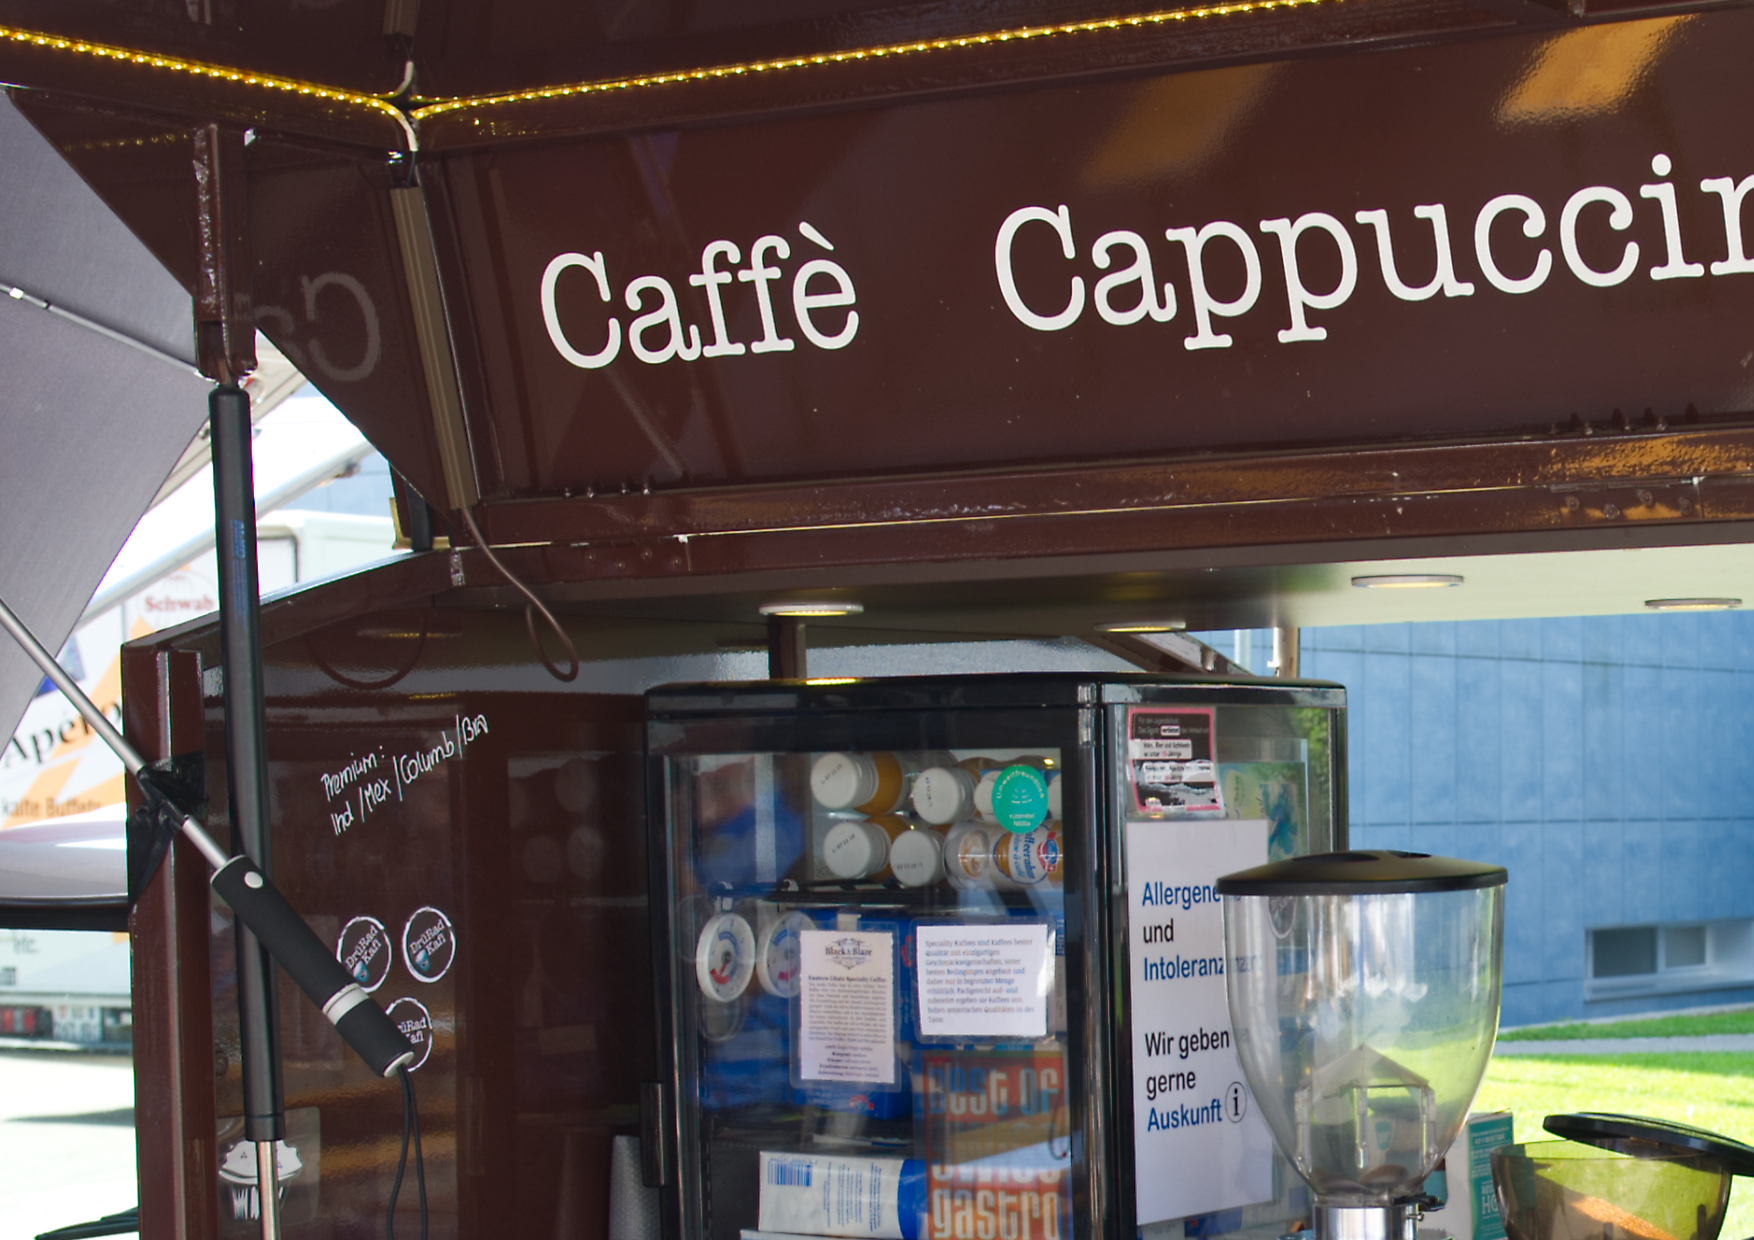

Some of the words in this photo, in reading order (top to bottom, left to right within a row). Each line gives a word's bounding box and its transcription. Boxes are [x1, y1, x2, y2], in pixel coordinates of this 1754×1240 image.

[541, 221, 859, 369] Caffè
[1143, 918, 1174, 943] und
[1145, 1031, 1174, 1057] Wir
[1179, 1028, 1230, 1060] geben
[1146, 1070, 1196, 1101] gerne
[1147, 1098, 1222, 1132] Auskunft
